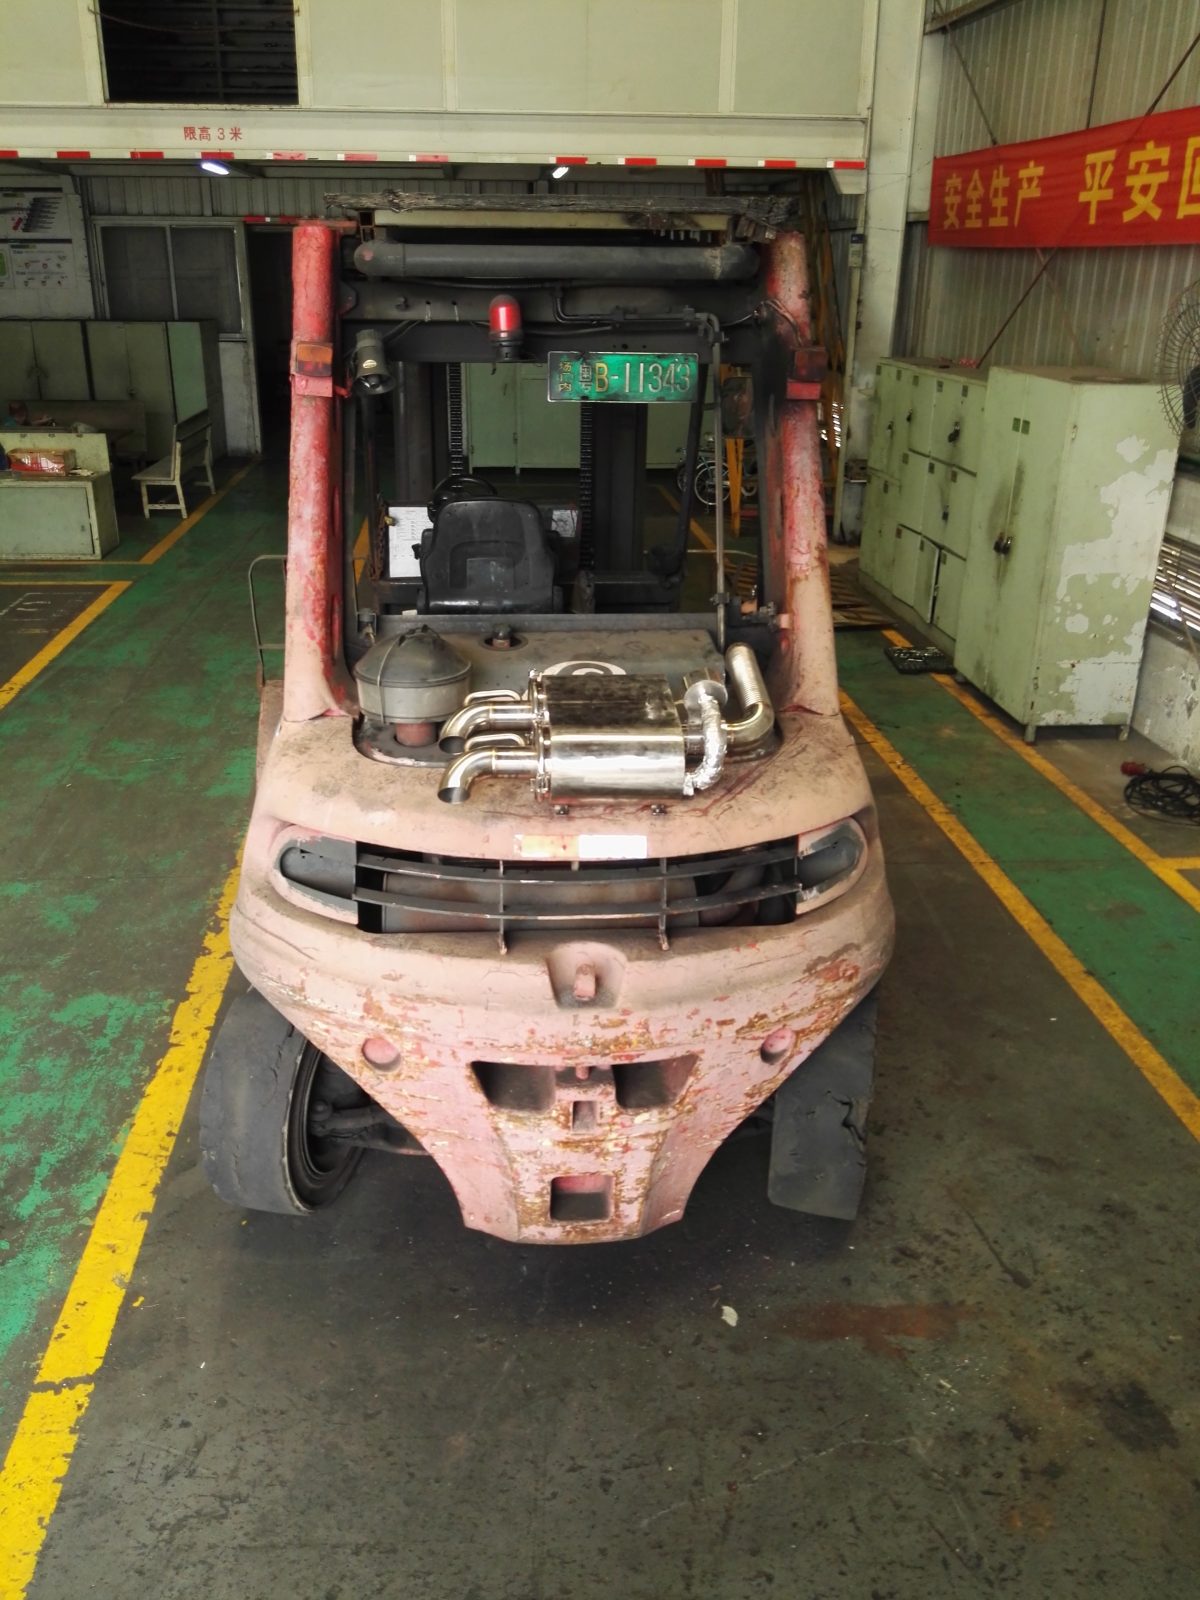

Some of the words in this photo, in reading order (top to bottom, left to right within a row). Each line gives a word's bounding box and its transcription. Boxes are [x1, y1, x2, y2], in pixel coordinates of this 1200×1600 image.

[183, 126, 242, 141] 限高3米
[943, 160, 1045, 229] 安全生产
